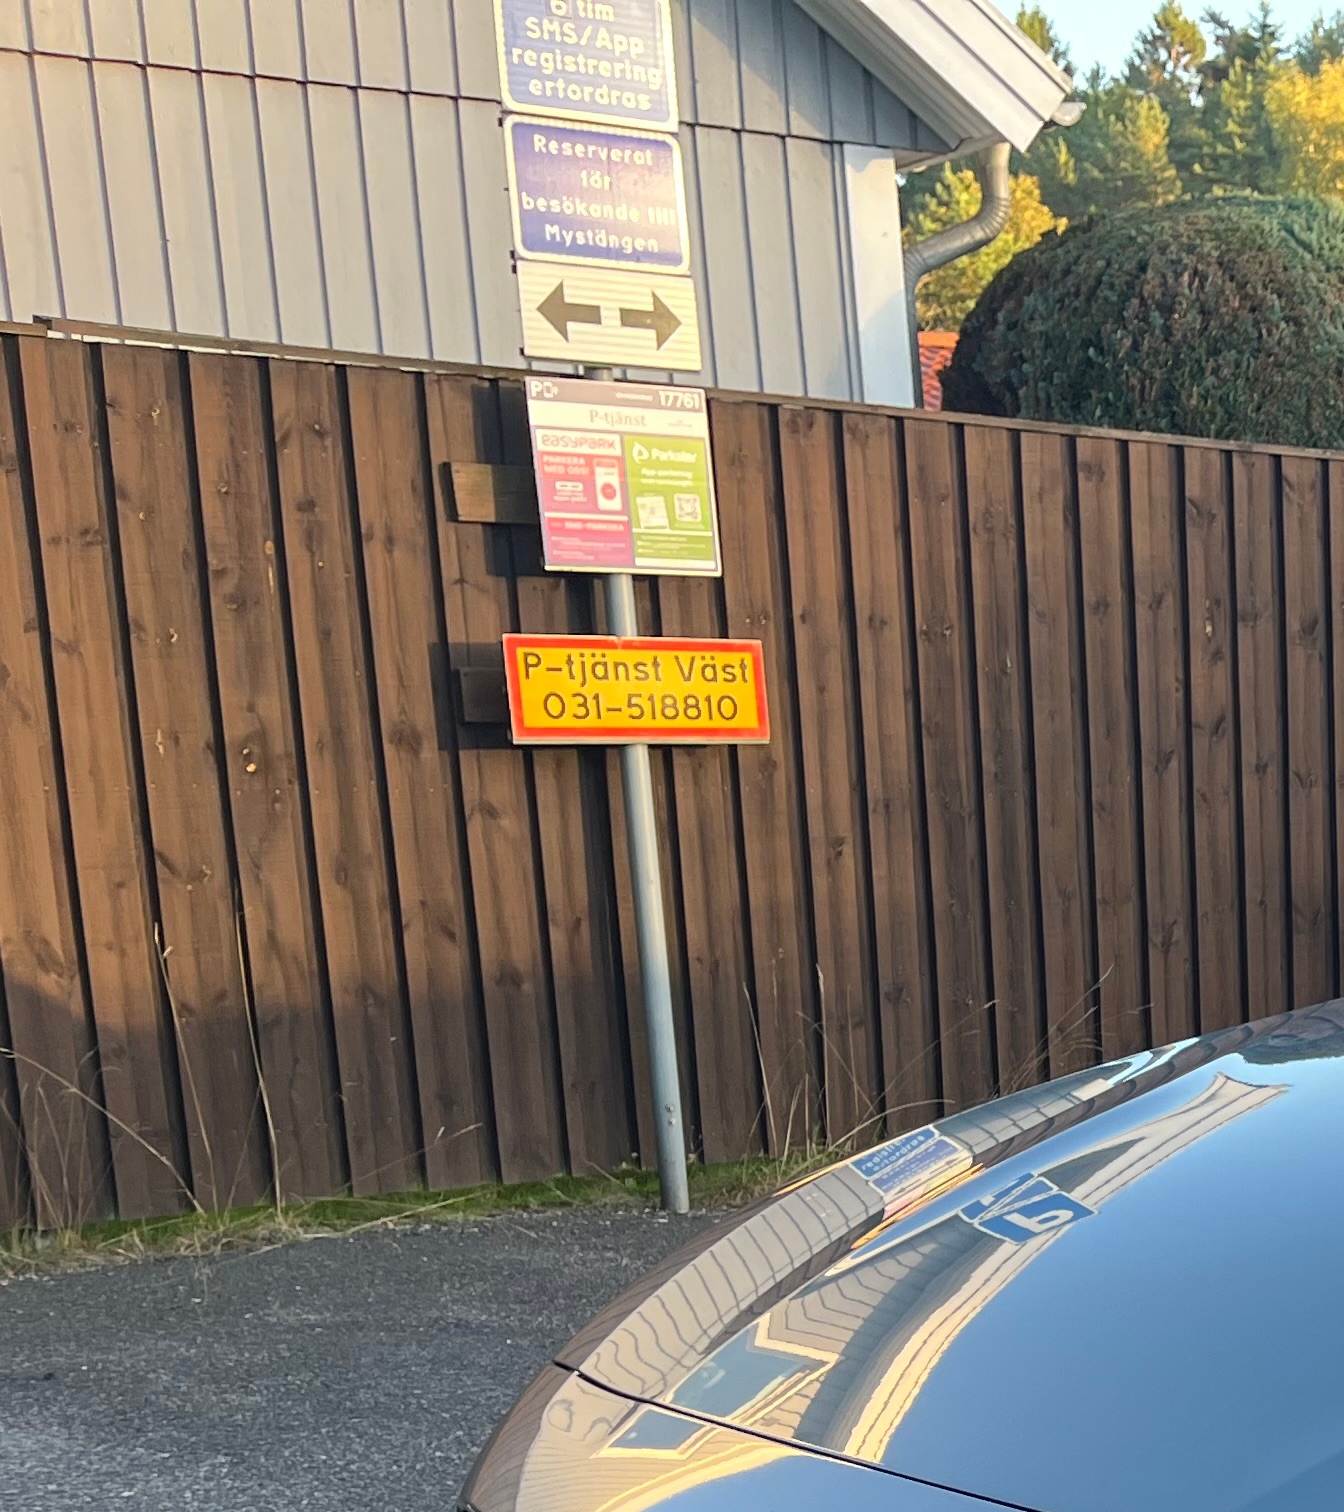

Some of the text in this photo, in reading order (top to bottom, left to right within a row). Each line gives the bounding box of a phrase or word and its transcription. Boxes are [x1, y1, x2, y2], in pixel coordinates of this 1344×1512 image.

[576, 0, 615, 22] tim
[525, 16, 645, 58] SMS/App
[511, 47, 663, 91] registrering
[528, 78, 653, 110] erfordras
[533, 134, 653, 166] Reserverat
[580, 168, 612, 190] för
[521, 191, 640, 222] besökande
[544, 223, 660, 254] Mystängen
[658, 390, 700, 409] 17761
[589, 409, 647, 427] P-tjänst
[523, 652, 749, 687] P-tjänst Väst
[543, 691, 738, 721] 031-518810
